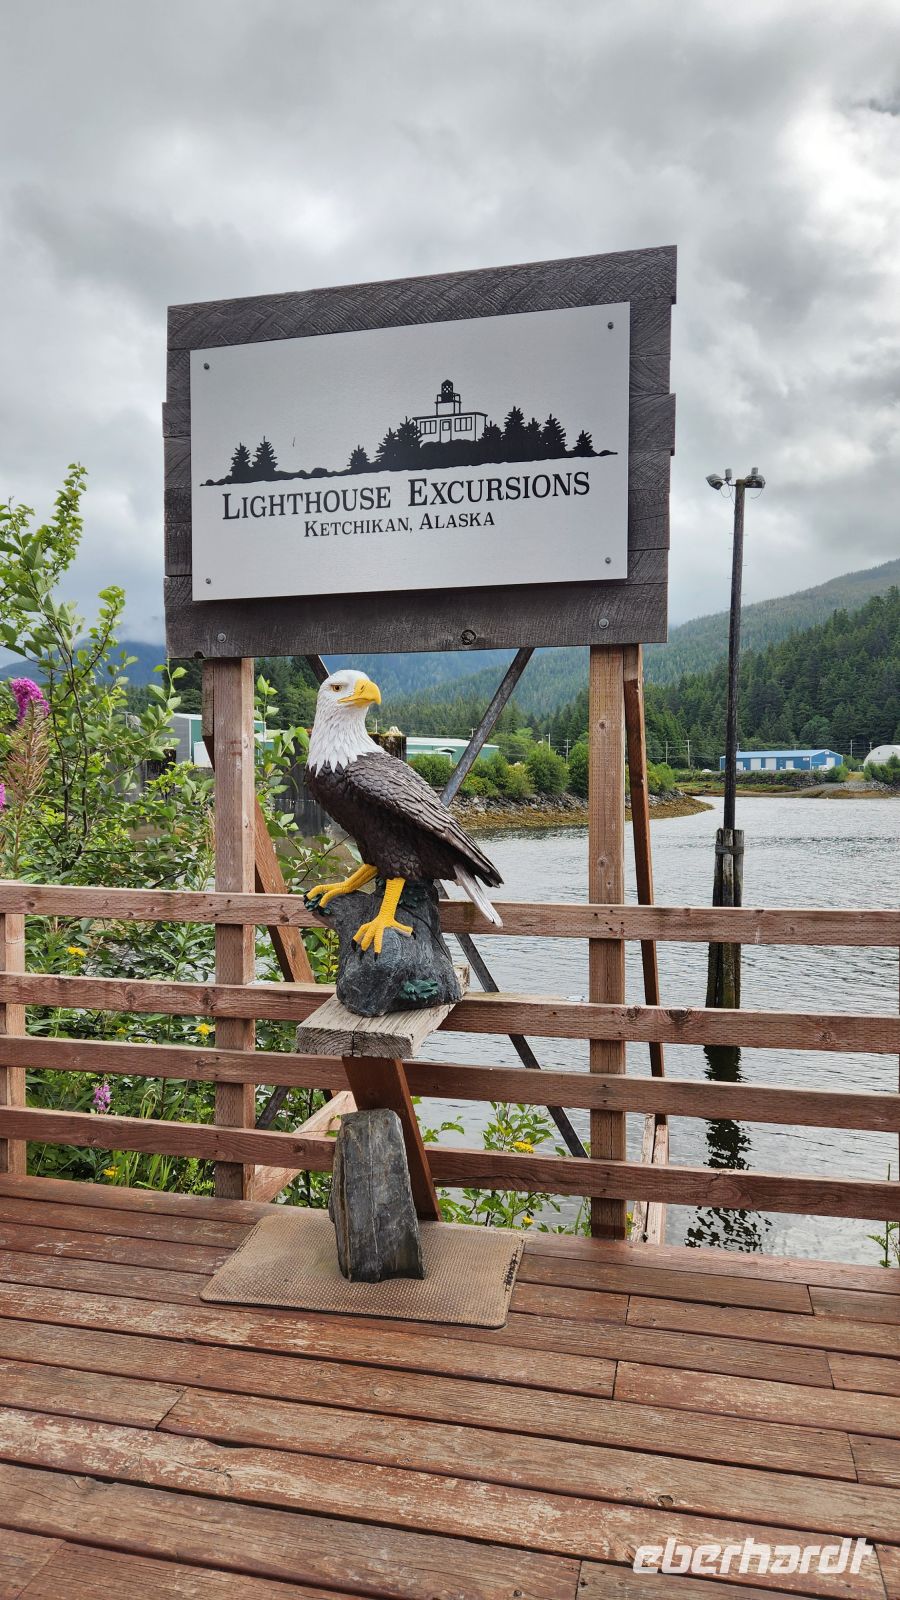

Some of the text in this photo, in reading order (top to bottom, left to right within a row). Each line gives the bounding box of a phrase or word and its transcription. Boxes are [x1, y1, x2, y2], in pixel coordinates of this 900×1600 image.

[222, 471, 590, 520] LIGHTHOUSE EXCURSIONS
[303, 511, 495, 538] KETCHIKAN, ALASKA
